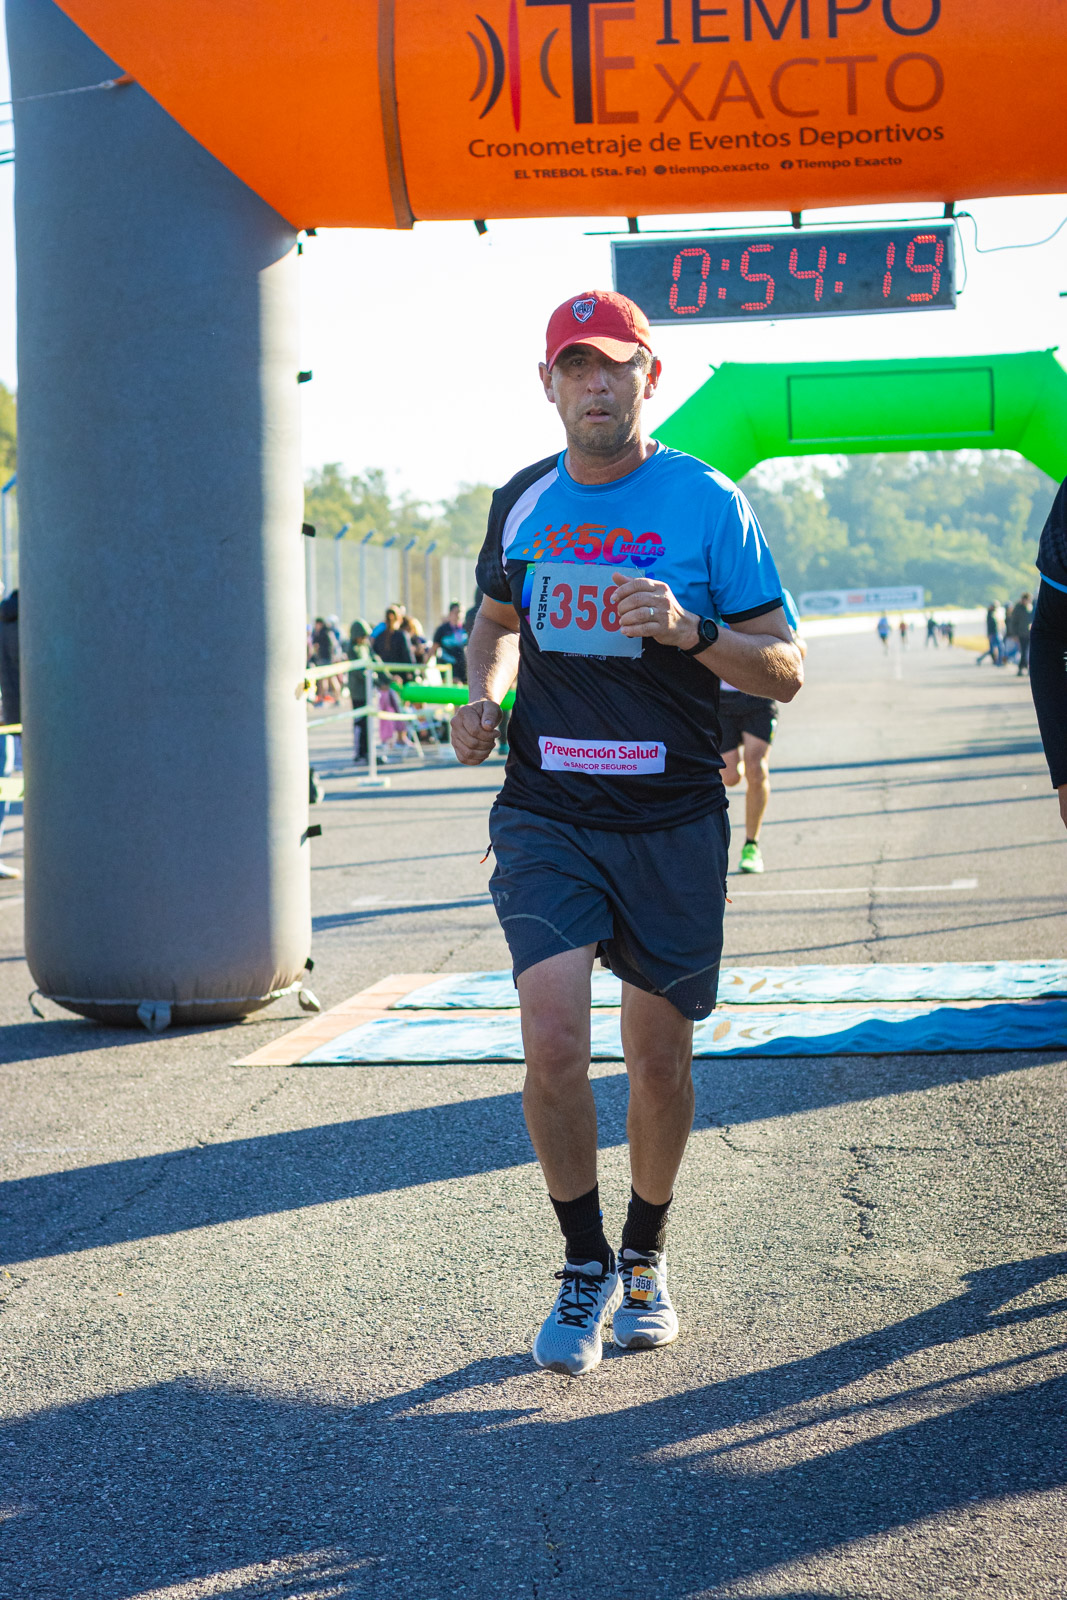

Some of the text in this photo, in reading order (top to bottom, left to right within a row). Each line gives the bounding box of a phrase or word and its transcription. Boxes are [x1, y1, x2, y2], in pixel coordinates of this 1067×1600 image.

[595, 7, 945, 125] EXACTO
[468, 124, 944, 159] Cronometraje de Eventos Deportivos
[514, 156, 902, 179] EL TREBOL (Sta. Fe) tiempo.exacto Tiempo Exacto
[669, 235, 944, 314] 0:54:19
[620, 543, 666, 557] MILLAS
[536, 576, 551, 631] TIEMPO
[549, 582, 621, 632] 358
[544, 741, 659, 760] Prevención Salud
[570, 762, 599, 770] SANCOR
[601, 763, 638, 771] SEGUROS
[635, 1277, 651, 1290] 358
